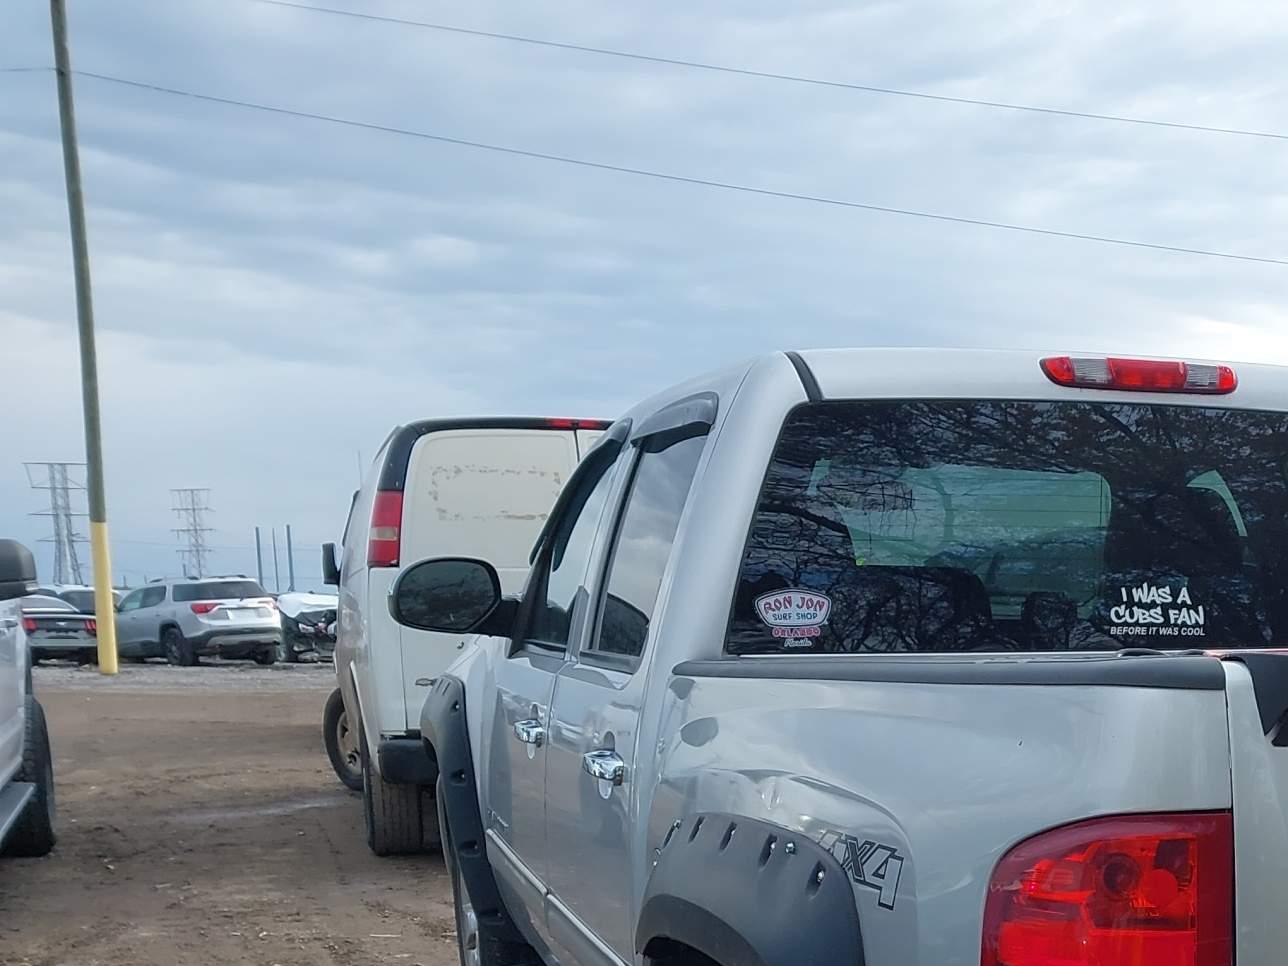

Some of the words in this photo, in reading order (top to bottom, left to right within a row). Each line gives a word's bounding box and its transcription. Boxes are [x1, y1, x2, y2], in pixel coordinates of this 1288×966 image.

[1121, 586, 1128, 602] I
[1132, 582, 1173, 603] WAS
[1176, 586, 1192, 605] A
[764, 596, 792, 614] RON
[796, 597, 825, 611] JON
[773, 613, 793, 621] SURF
[1110, 604, 1164, 624] CUBS
[1168, 605, 1205, 625] FAN
[1110, 626, 1147, 635] BEFORE
[1148, 626, 1158, 635] IT
[1159, 627, 1179, 636] WAS
[1181, 627, 1206, 636] COOL
